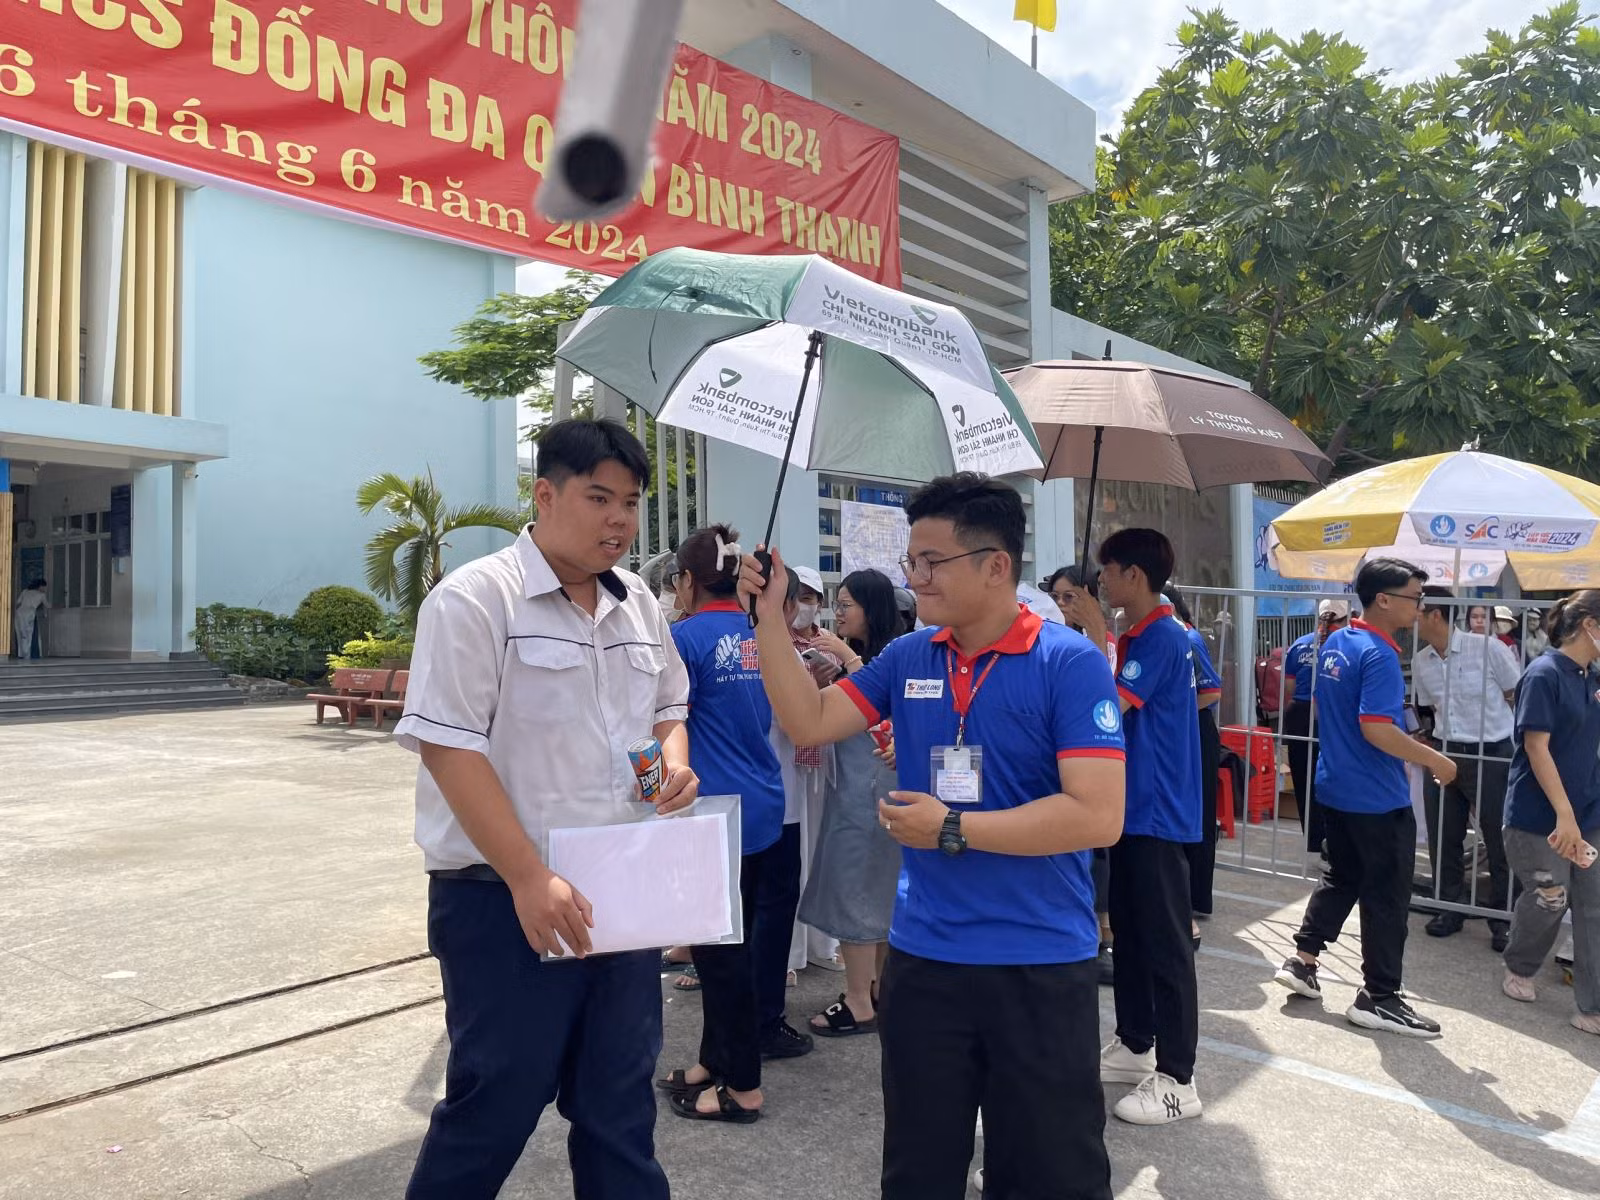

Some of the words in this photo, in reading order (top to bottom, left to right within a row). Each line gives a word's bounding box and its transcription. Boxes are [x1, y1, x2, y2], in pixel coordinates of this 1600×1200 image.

[210, 0, 407, 128] ĐỐNG
[427, 77, 506, 161] ĐA
[667, 161, 765, 237] BÌNH
[656, 63, 729, 143] ĂM
[741, 103, 822, 175] 2024
[65, 70, 318, 187] tháng
[340, 148, 378, 193] 6
[397, 176, 531, 238] năm
[822, 300, 844, 314] CHI
[824, 284, 960, 345] Vietcombank
[1205, 410, 1253, 425] TOYOTA
[1551, 532, 1577, 545] 2024
